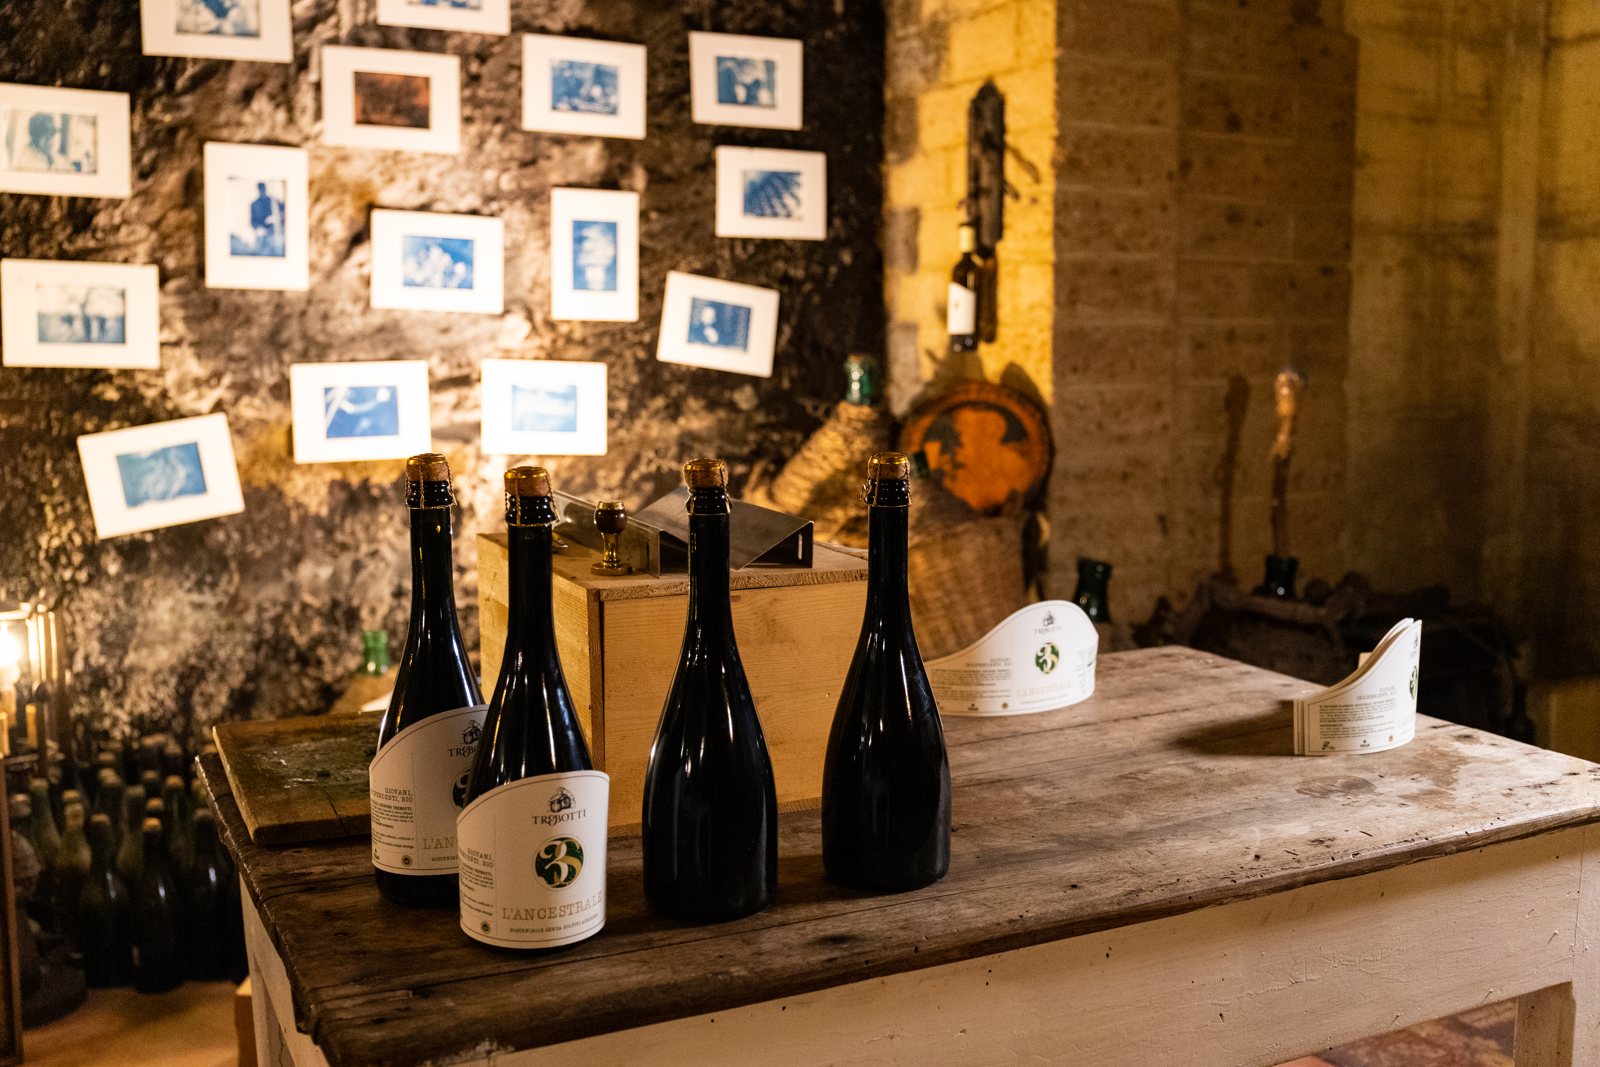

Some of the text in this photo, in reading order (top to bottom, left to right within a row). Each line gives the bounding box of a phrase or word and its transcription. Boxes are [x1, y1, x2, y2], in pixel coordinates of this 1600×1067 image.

[531, 809, 587, 826] TREBOTTI
[422, 836, 458, 850] L'AN
[502, 890, 602, 921] L'ANCESTRALE
